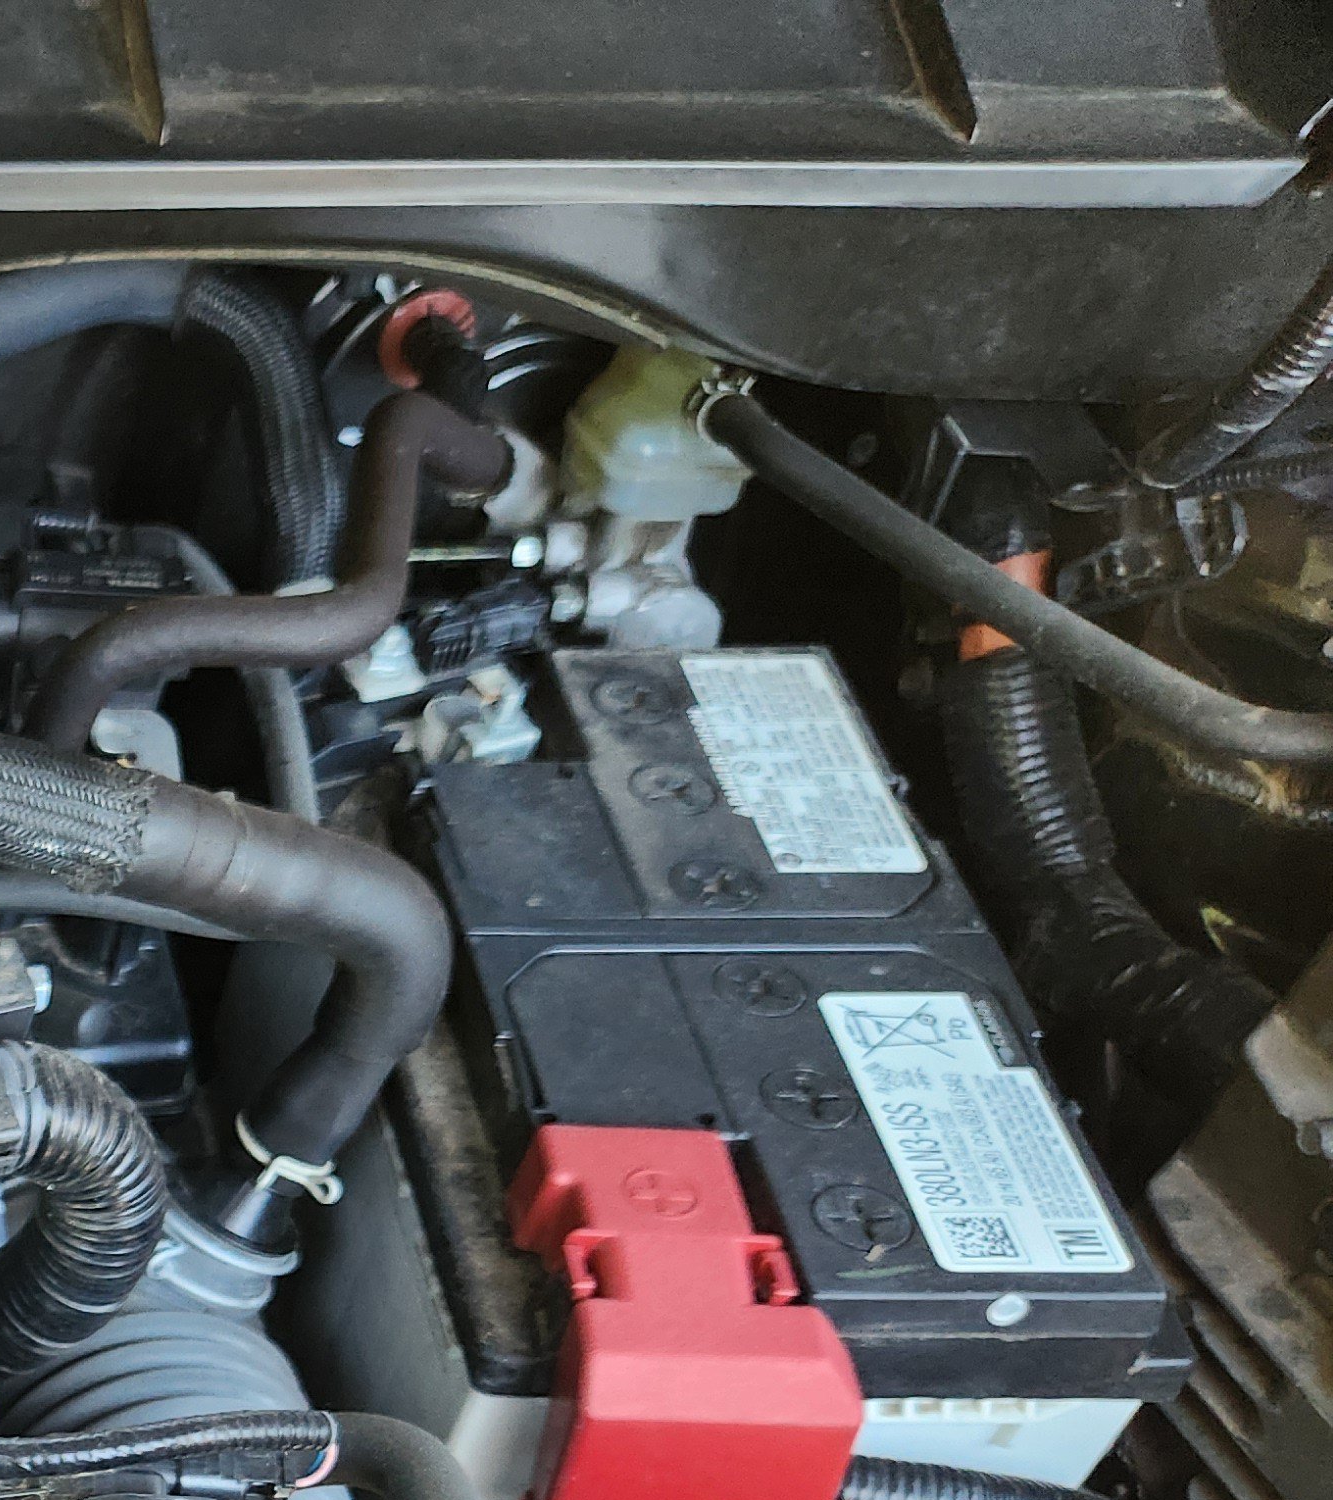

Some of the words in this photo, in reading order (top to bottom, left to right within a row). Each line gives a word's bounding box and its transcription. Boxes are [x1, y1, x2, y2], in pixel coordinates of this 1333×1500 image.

[947, 1018, 969, 1039] Pb
[881, 1103, 968, 1207] 380LN3-ISS
[1060, 1230, 1109, 1260] TM
